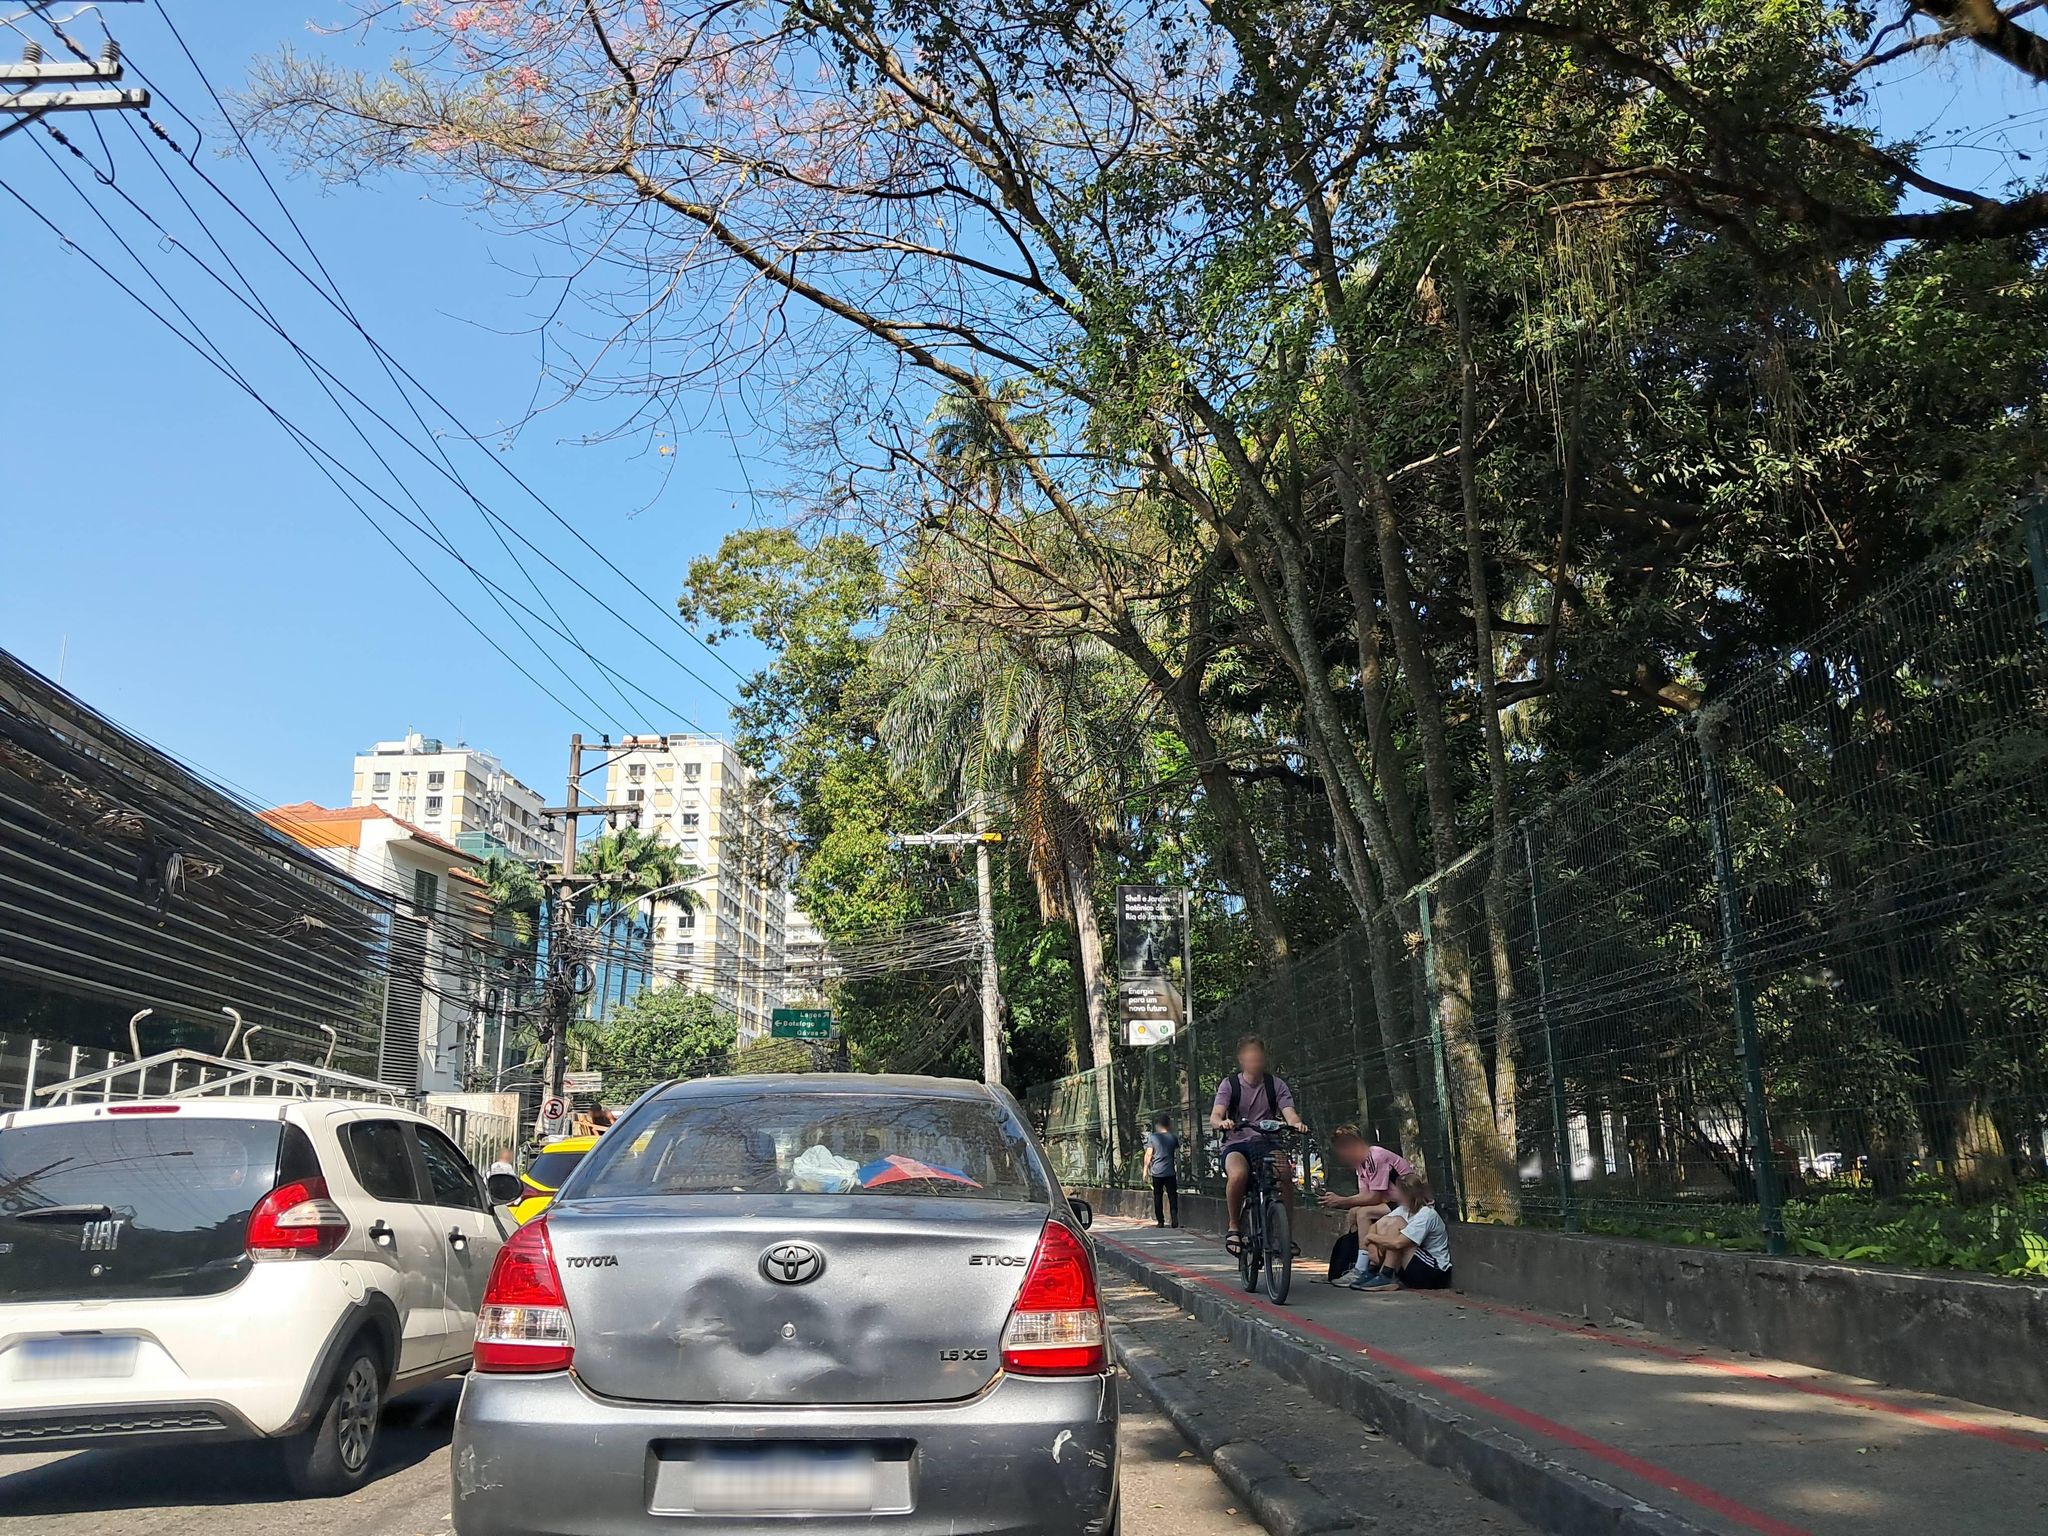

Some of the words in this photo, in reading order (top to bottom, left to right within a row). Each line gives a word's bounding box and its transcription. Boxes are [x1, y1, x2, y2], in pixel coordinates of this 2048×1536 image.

[1125, 894, 1141, 902] Shell
[1128, 987, 1154, 996] Energia
[1146, 1004, 1167, 1012] futuro
[783, 1020, 815, 1028] Botafogo
[80, 1220, 124, 1251] FIAT
[566, 1255, 618, 1268] TOYOTA
[968, 1255, 1026, 1267] ETIOS
[962, 1350, 987, 1361] XS
